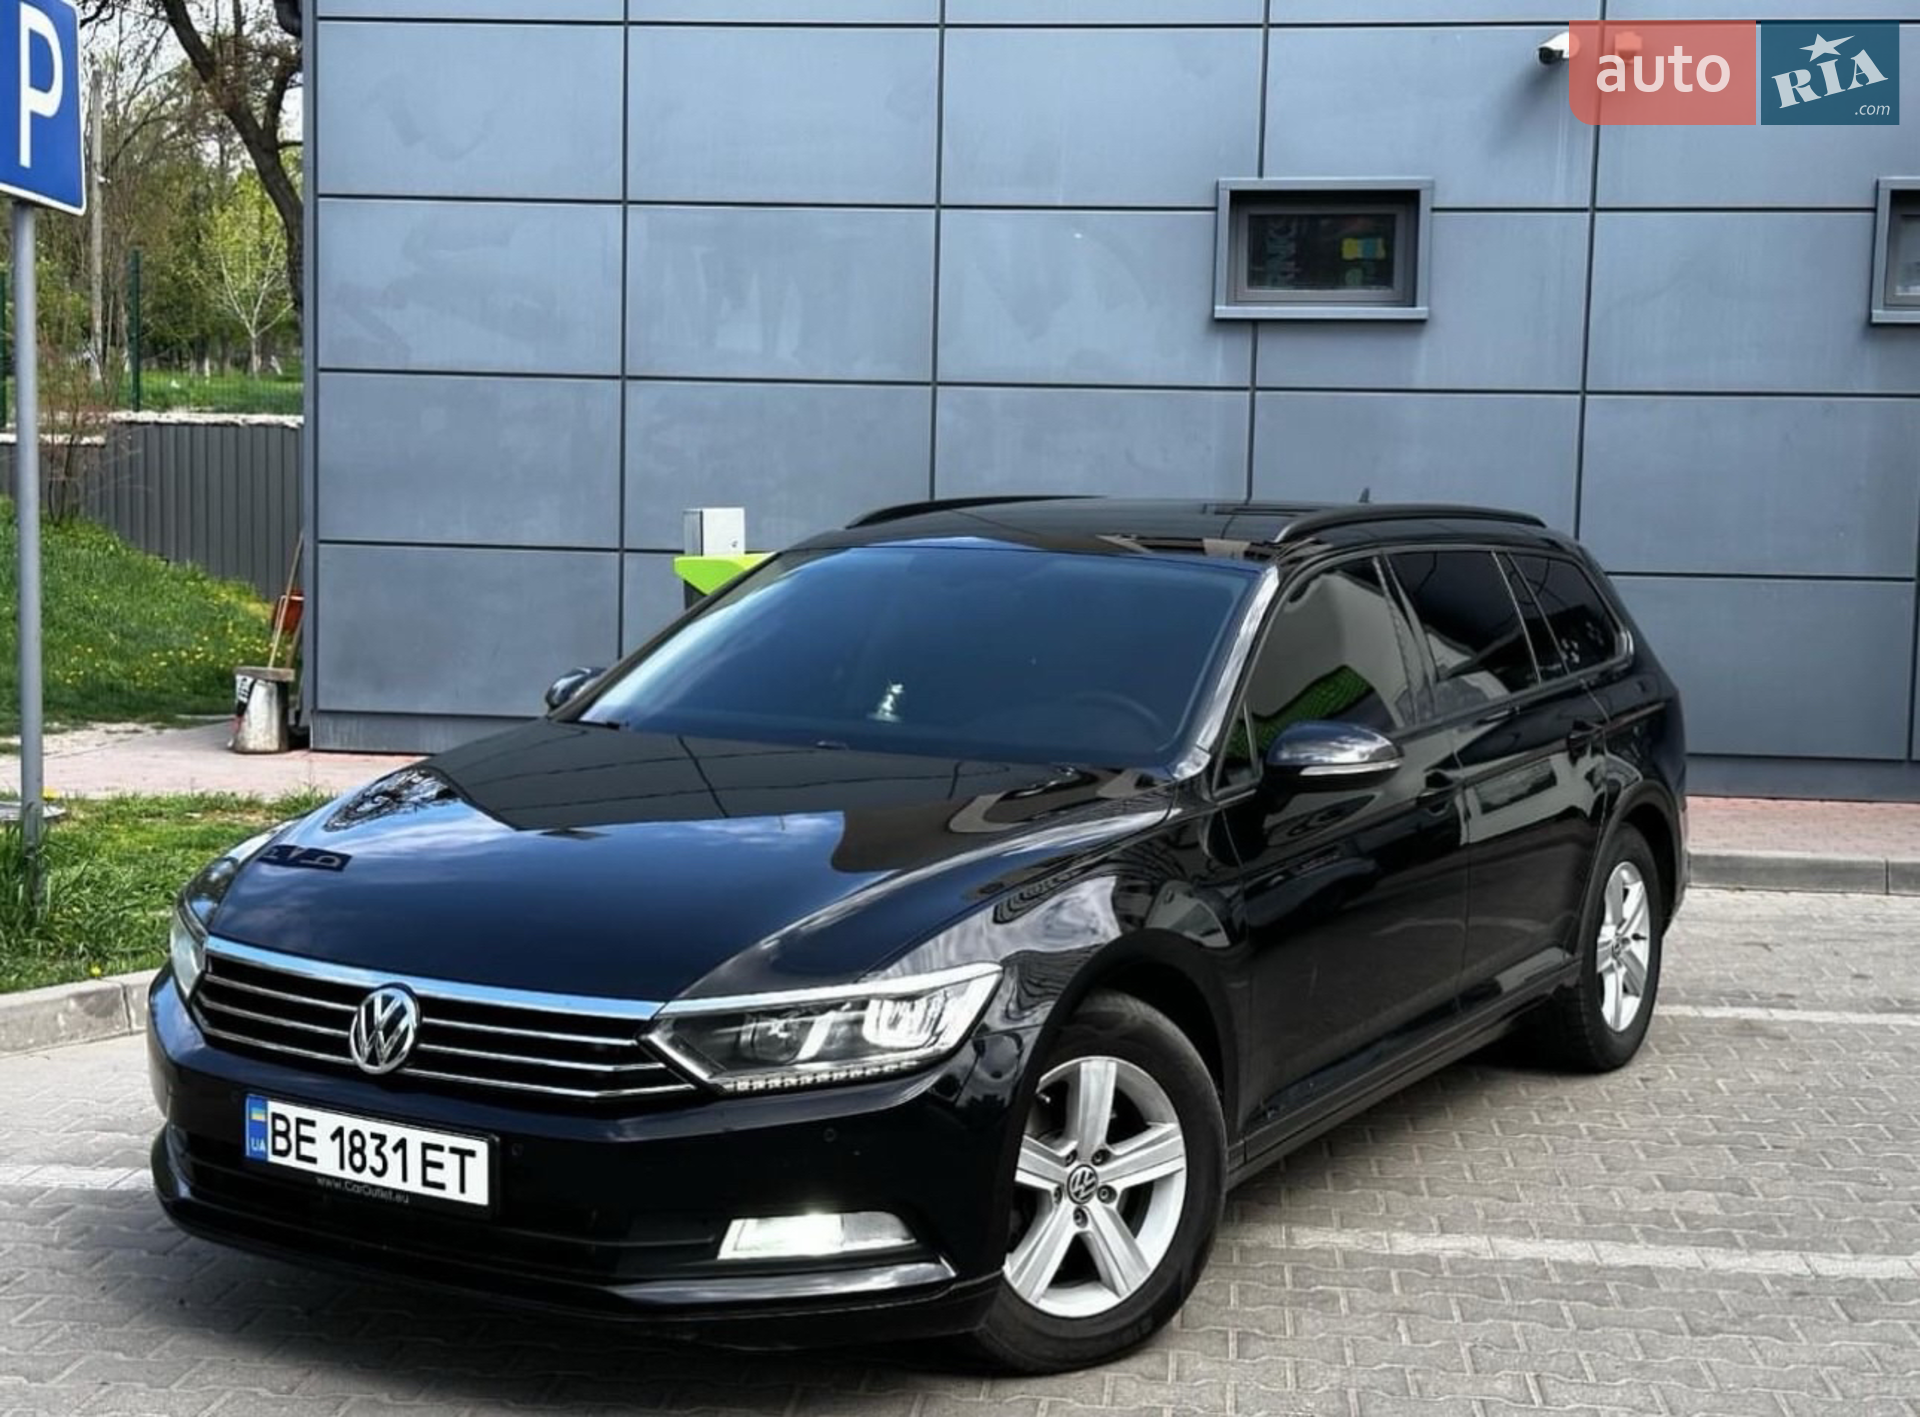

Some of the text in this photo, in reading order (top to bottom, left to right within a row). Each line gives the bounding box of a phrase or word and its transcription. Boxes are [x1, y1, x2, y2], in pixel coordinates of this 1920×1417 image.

[19, 2, 63, 168] P
[250, 1136, 267, 1152] UA
[271, 1111, 477, 1194] BE 1831 ET
